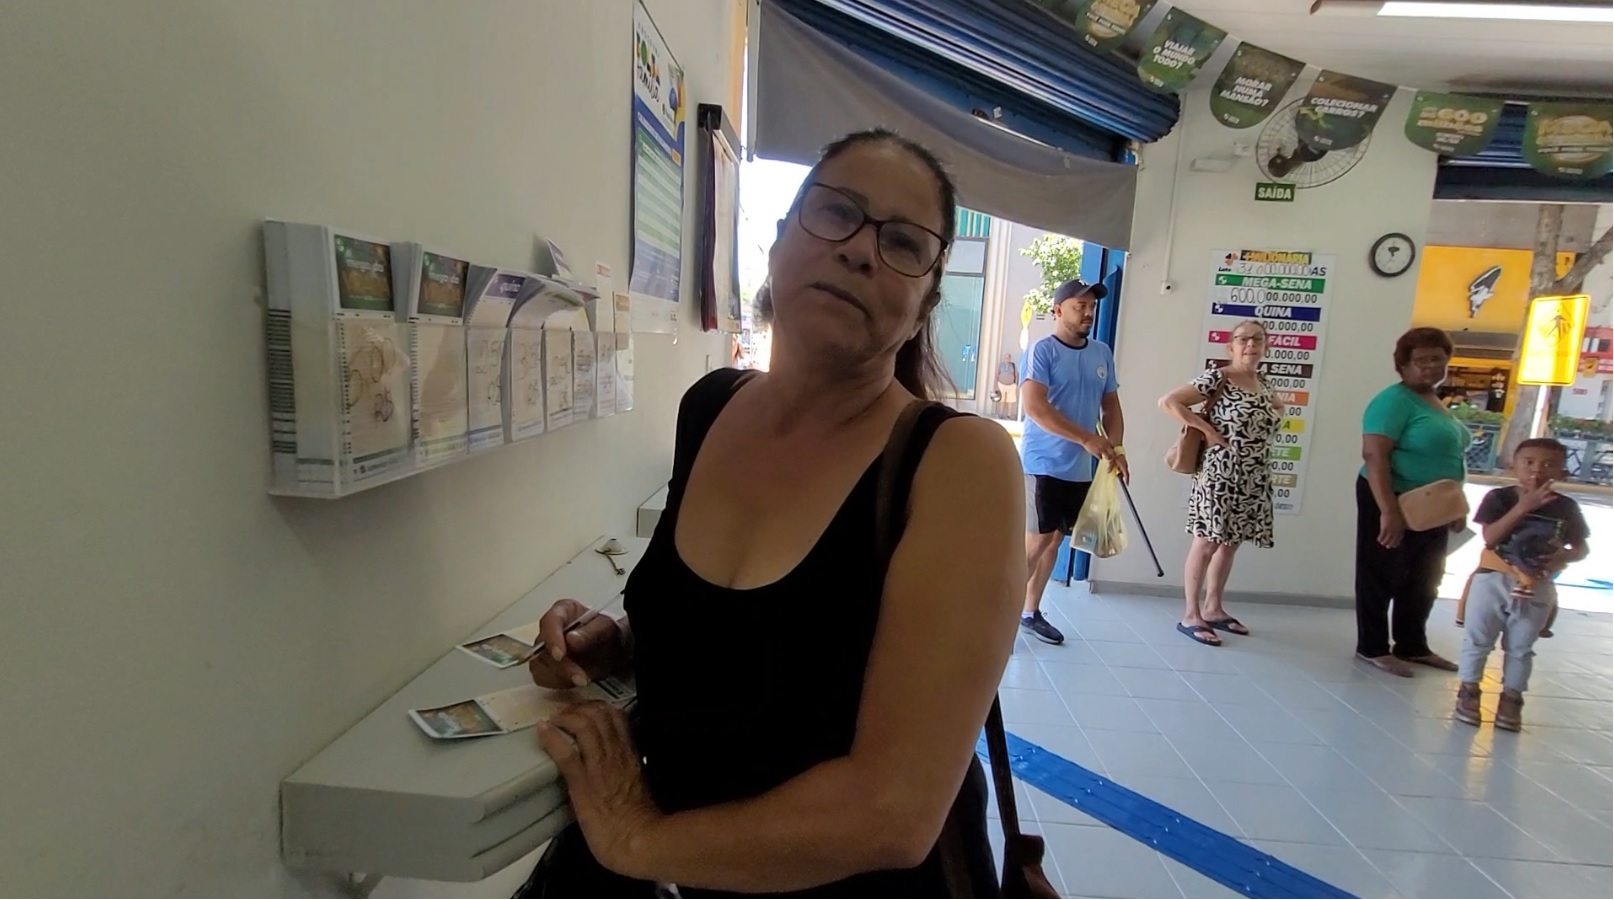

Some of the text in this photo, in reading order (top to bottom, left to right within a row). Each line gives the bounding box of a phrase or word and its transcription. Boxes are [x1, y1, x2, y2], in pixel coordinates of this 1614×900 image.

[1164, 39, 1196, 56] VIAJAR
[1152, 45, 1196, 65] O MUNDO
[1234, 76, 1273, 92] MORAR
[1232, 85, 1265, 98] NUMA
[1310, 97, 1379, 114] COLECIONAR
[1257, 185, 1292, 200] SAÍDA
[1241, 276, 1312, 290] MEGA-SENA
[1254, 306, 1292, 318] QUINA
[1263, 320, 1314, 333] 00.000,00
[1264, 349, 1310, 361] 0.000,00
[1270, 363, 1303, 375] SENA
